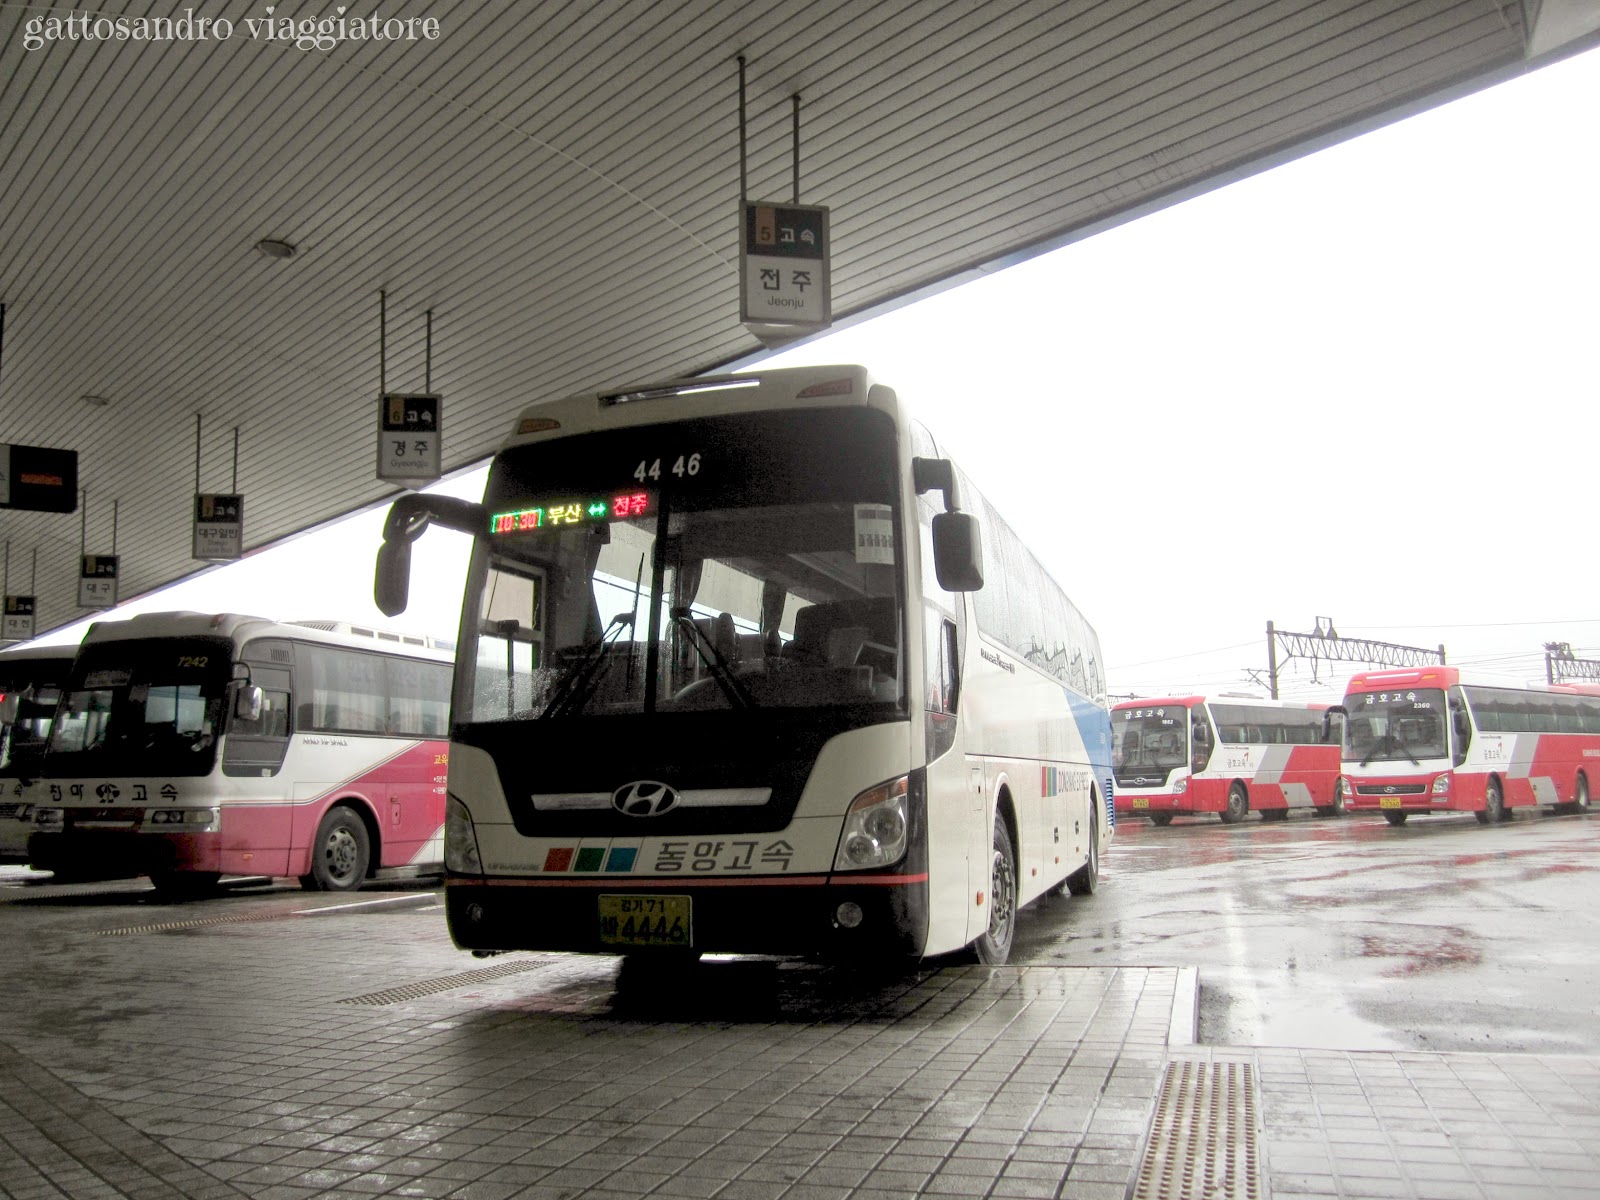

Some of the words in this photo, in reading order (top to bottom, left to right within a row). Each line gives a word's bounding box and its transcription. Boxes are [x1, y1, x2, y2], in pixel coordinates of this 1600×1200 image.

[760, 226, 771, 242] 5
[780, 227, 815, 245] 고속
[760, 268, 812, 292] 전주
[767, 295, 804, 309] Jeonju
[406, 409, 433, 423] 고속
[391, 440, 428, 457] 경주
[497, 510, 537, 532] 10:30
[548, 503, 581, 526] 부산
[613, 493, 648, 517] 전주
[1365, 691, 1416, 704] 금호고속
[1125, 708, 1165, 719] 금호고속
[132, 783, 178, 802] 고속
[654, 839, 795, 873] 동양고속
